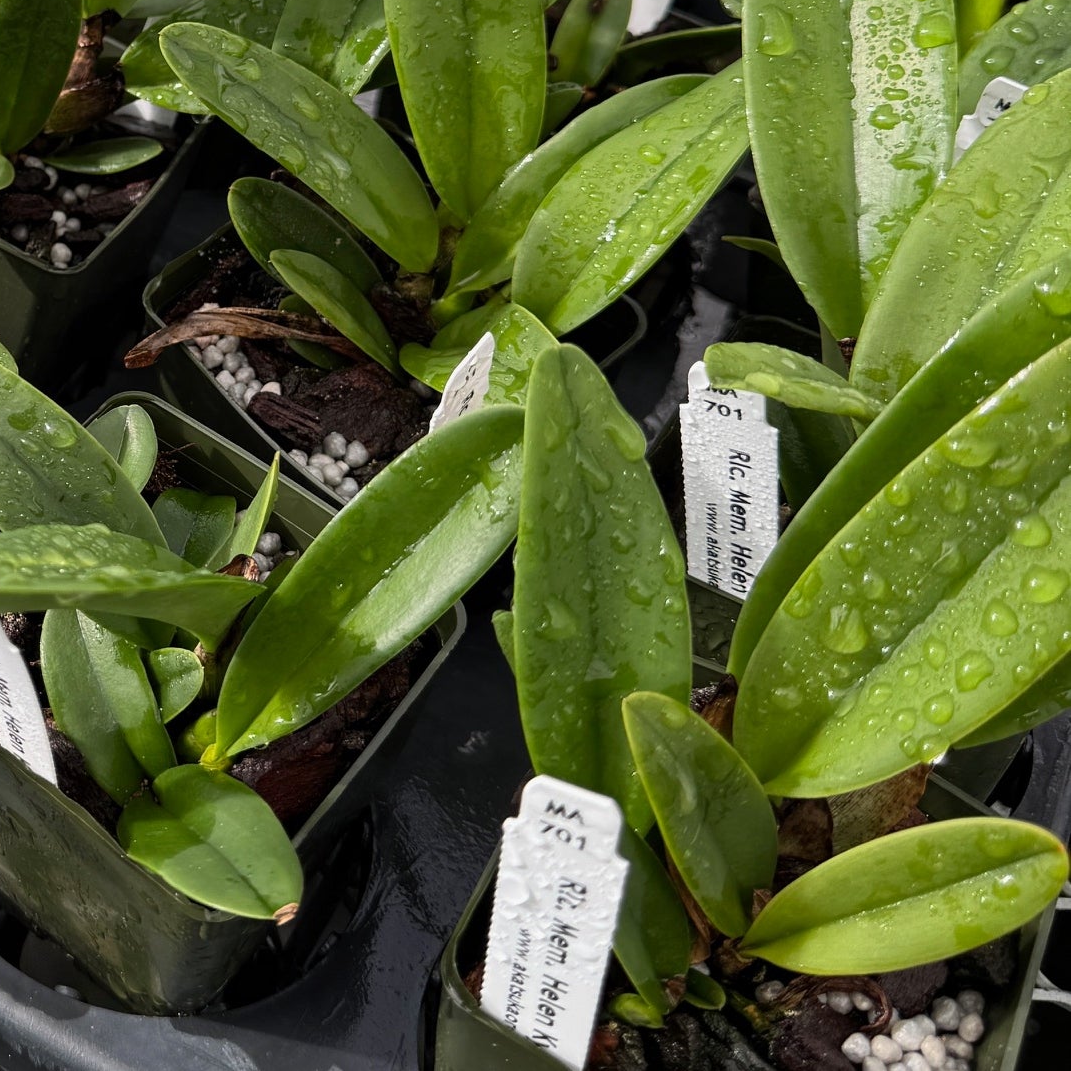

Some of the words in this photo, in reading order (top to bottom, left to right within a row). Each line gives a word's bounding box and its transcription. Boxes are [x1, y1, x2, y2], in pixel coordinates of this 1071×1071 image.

[993, 97, 1012, 112] M
[702, 398, 744, 421] 701
[729, 447, 753, 481] Rlc.
[729, 487, 752, 536] Mem.
[730, 542, 756, 594] Helen
[2, 711, 28, 757] Helen
[543, 798, 587, 827] MA
[539, 818, 588, 852] 701
[553, 875, 588, 912] Rlc.
[544, 916, 581, 968] Mem.
[504, 928, 533, 1031] www.akatsukaor
[534, 972, 570, 1028] Helen
